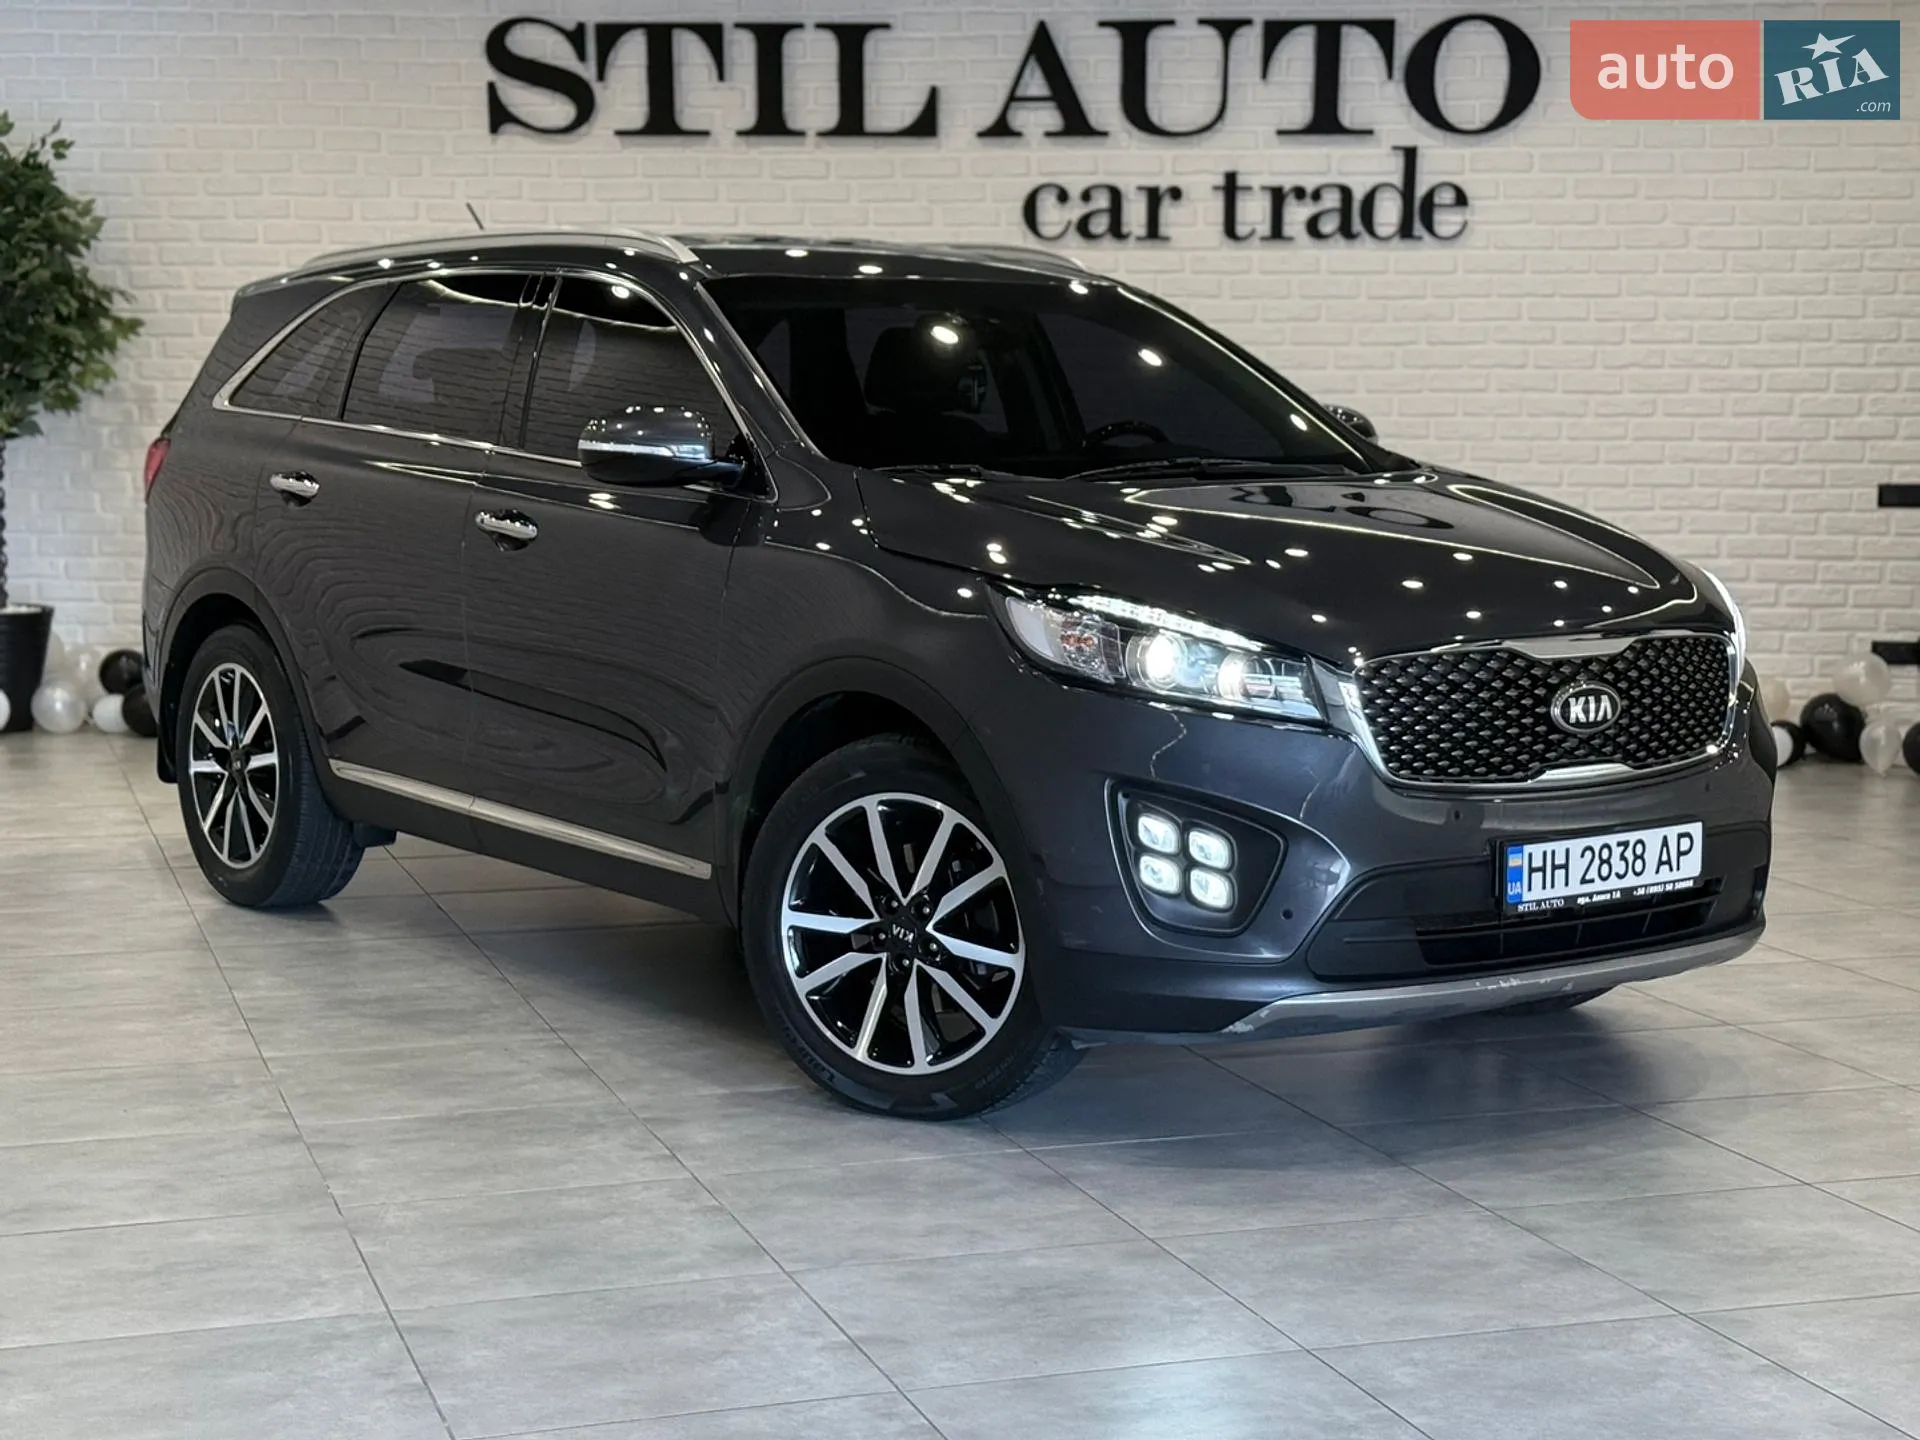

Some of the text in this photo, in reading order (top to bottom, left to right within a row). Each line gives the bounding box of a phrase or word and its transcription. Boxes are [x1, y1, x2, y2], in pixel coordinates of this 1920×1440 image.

[485, 14, 1541, 138] STIL AUTO
[1022, 147, 1468, 241] car trade
[1568, 695, 1613, 723] KIA
[1528, 831, 1694, 892] HH 2838 AP
[1507, 883, 1522, 896] UA
[1517, 899, 1565, 912] STIL AUTO
